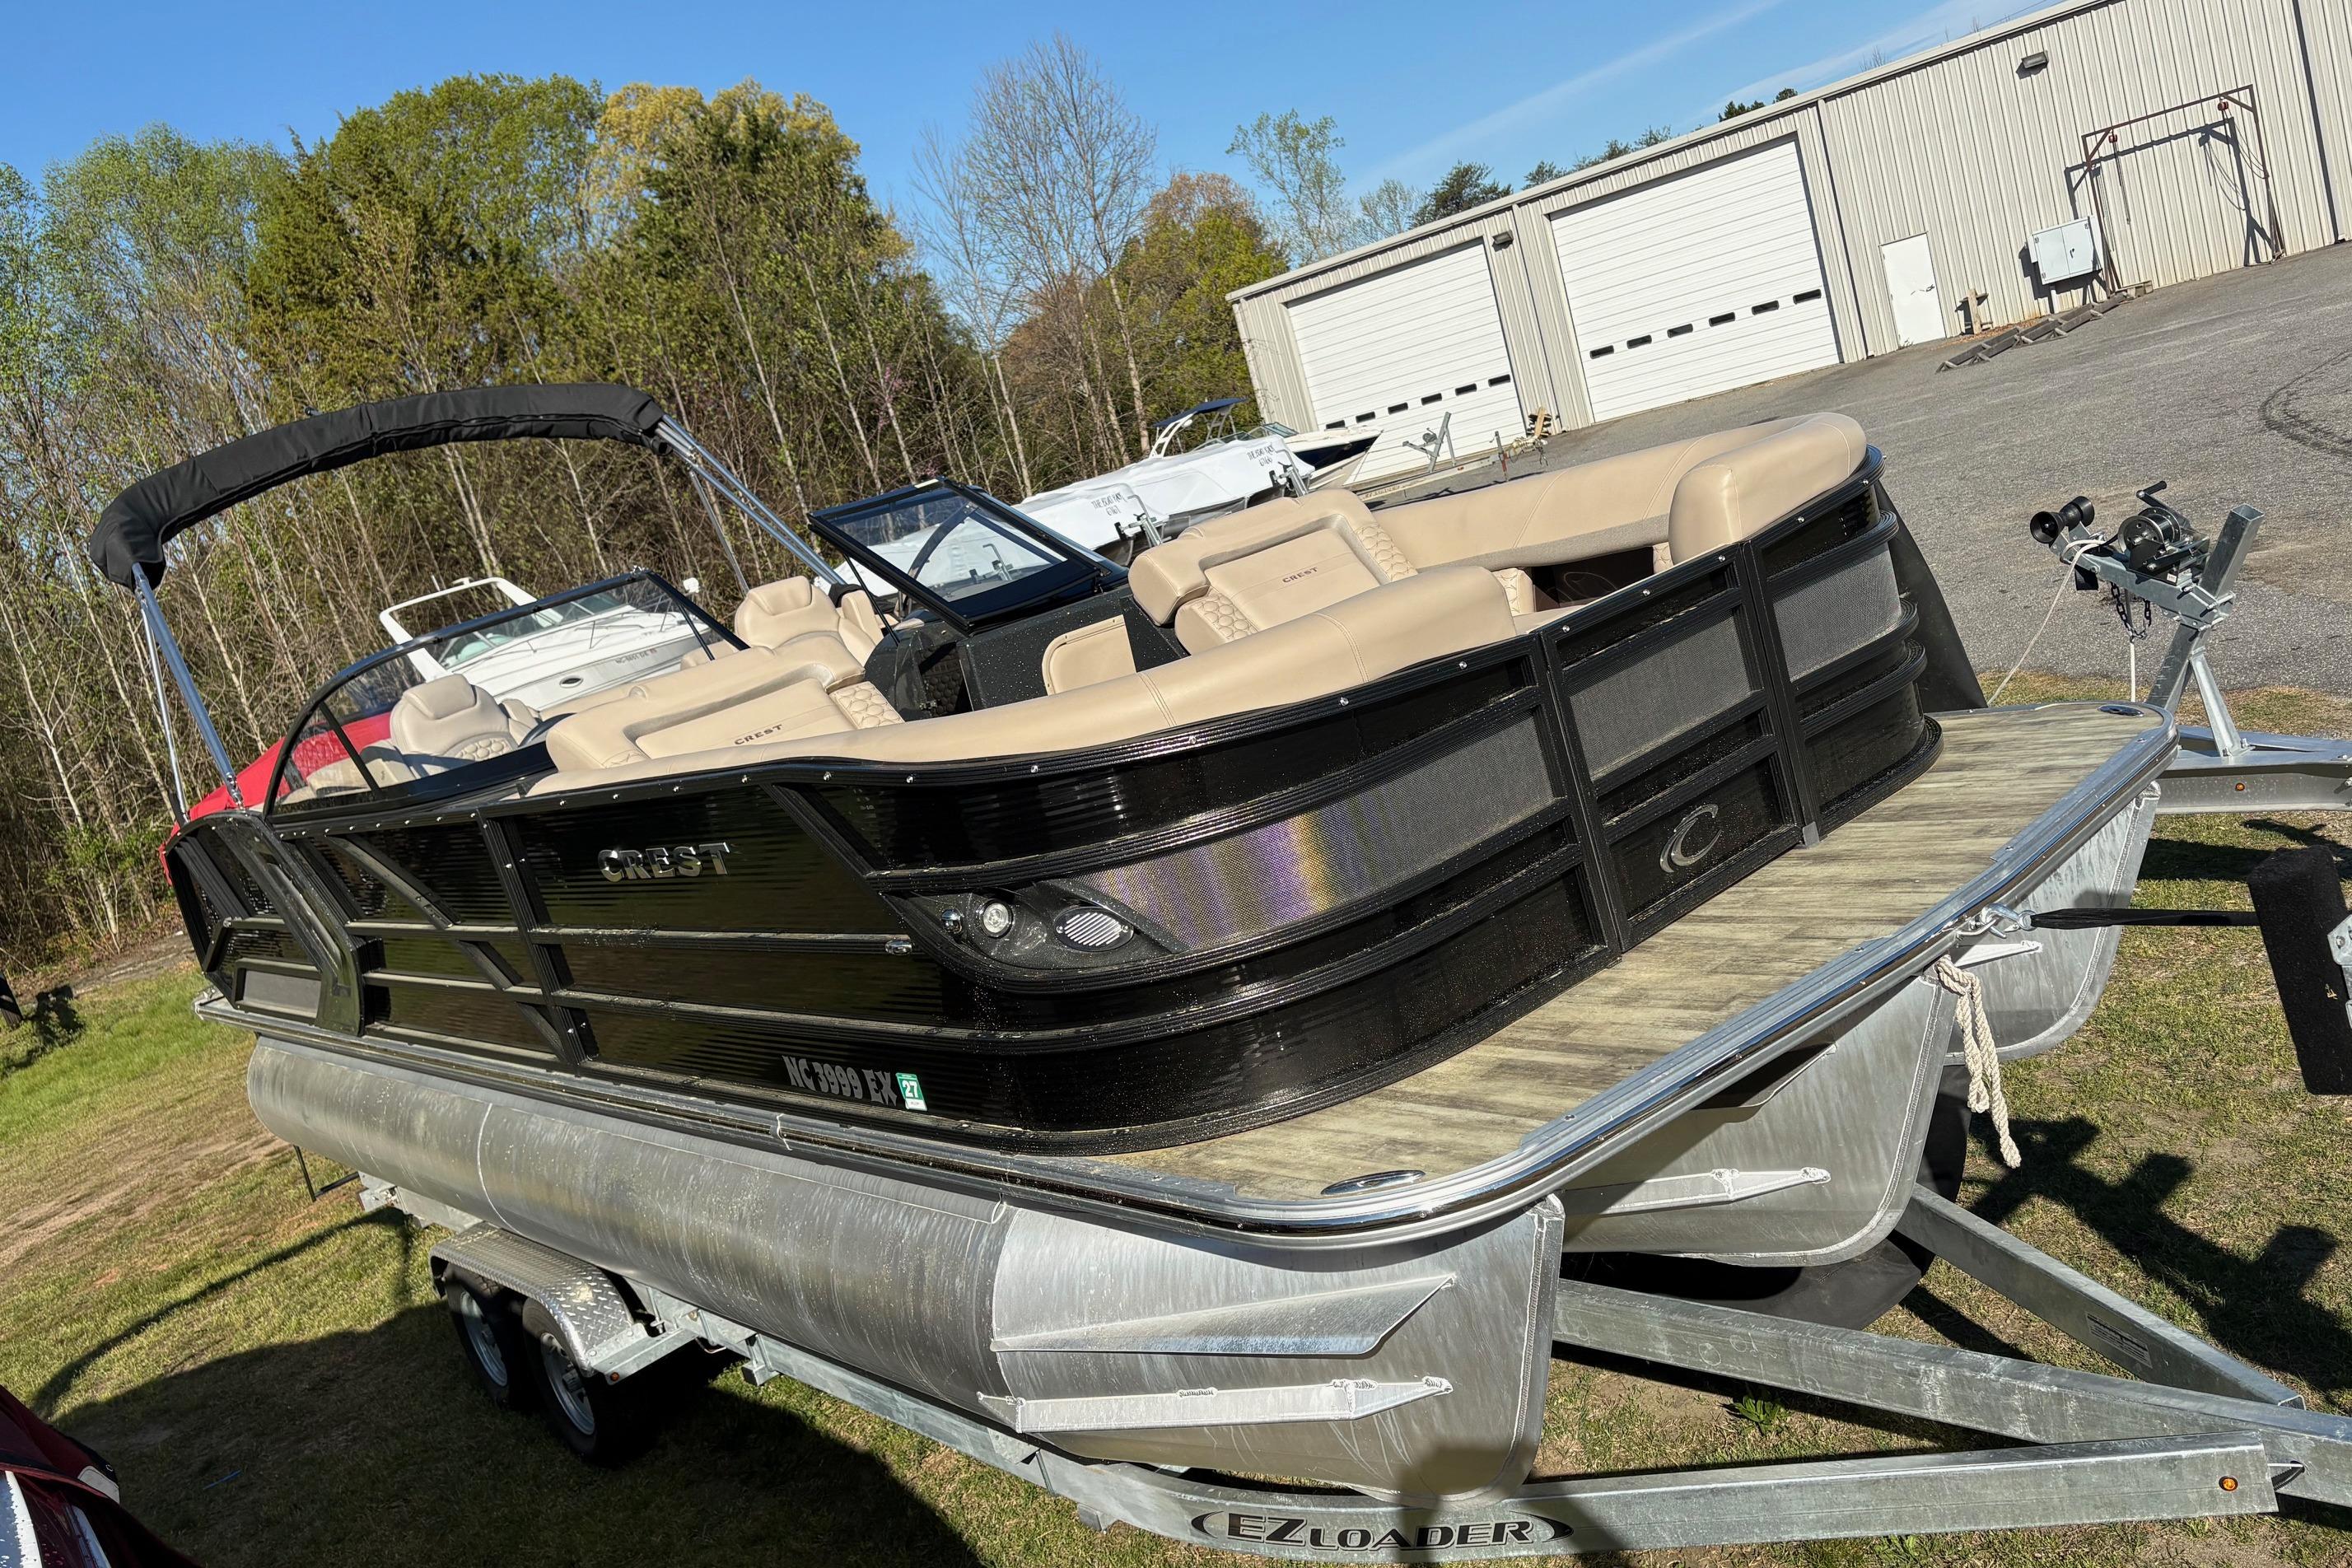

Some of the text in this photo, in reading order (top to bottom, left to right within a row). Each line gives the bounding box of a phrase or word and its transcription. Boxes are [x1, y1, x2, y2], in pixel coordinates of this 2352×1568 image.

[1282, 567, 1318, 583] CREST
[735, 725, 782, 745] CREST
[598, 842, 730, 882] CREST
[782, 1055, 897, 1107] NC 3999 EX
[902, 1080, 918, 1098] 27
